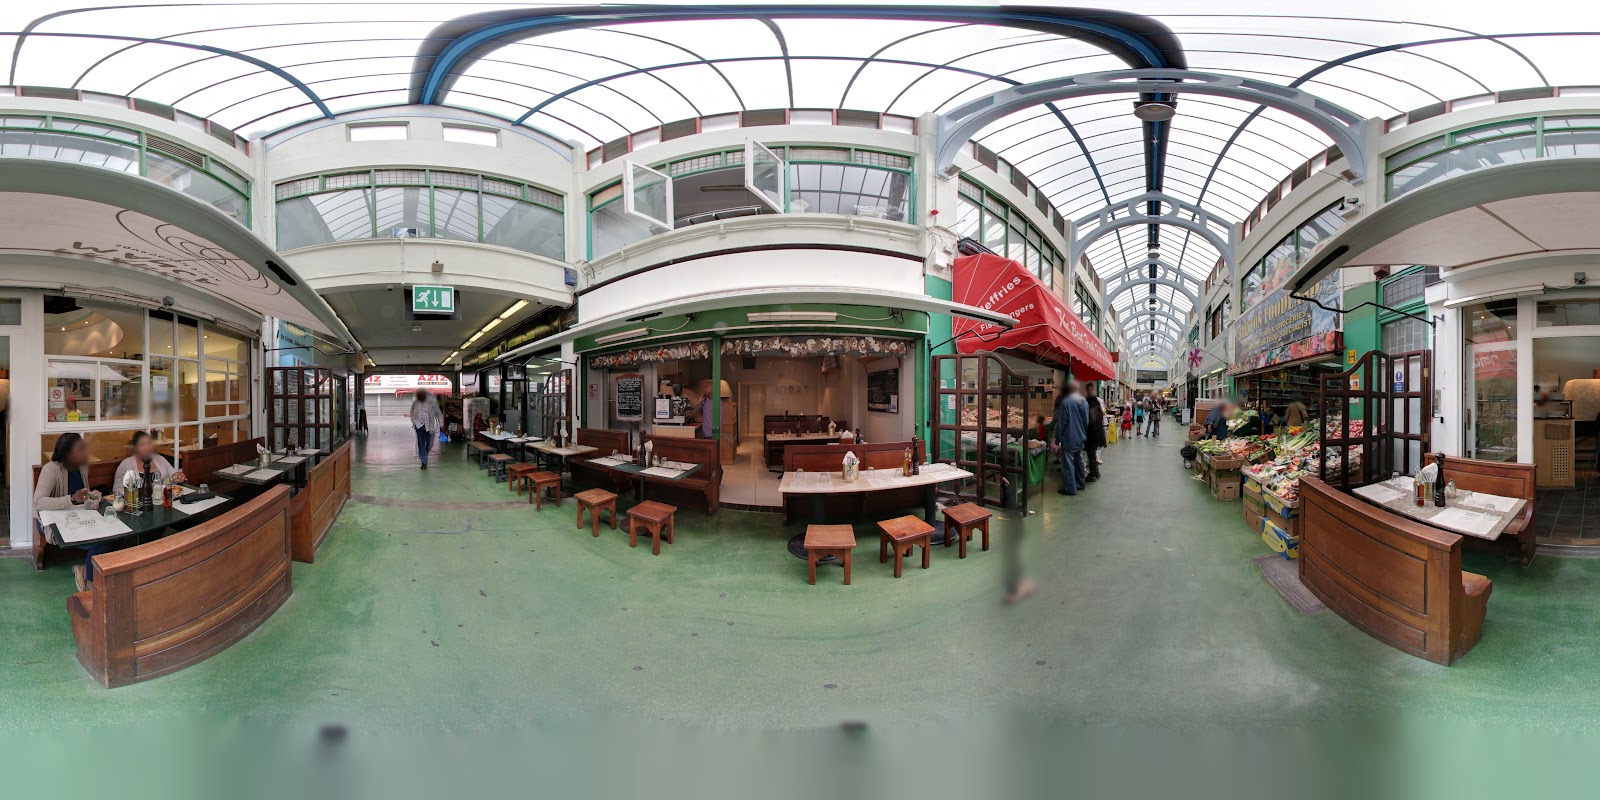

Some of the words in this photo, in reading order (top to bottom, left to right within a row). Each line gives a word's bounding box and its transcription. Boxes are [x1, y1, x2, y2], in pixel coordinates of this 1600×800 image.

[980, 303, 1035, 332] Fisngers
[1054, 306, 1071, 333] The
[1276, 309, 1307, 330] GROCERIES
[1280, 317, 1313, 338] SPECIALIST
